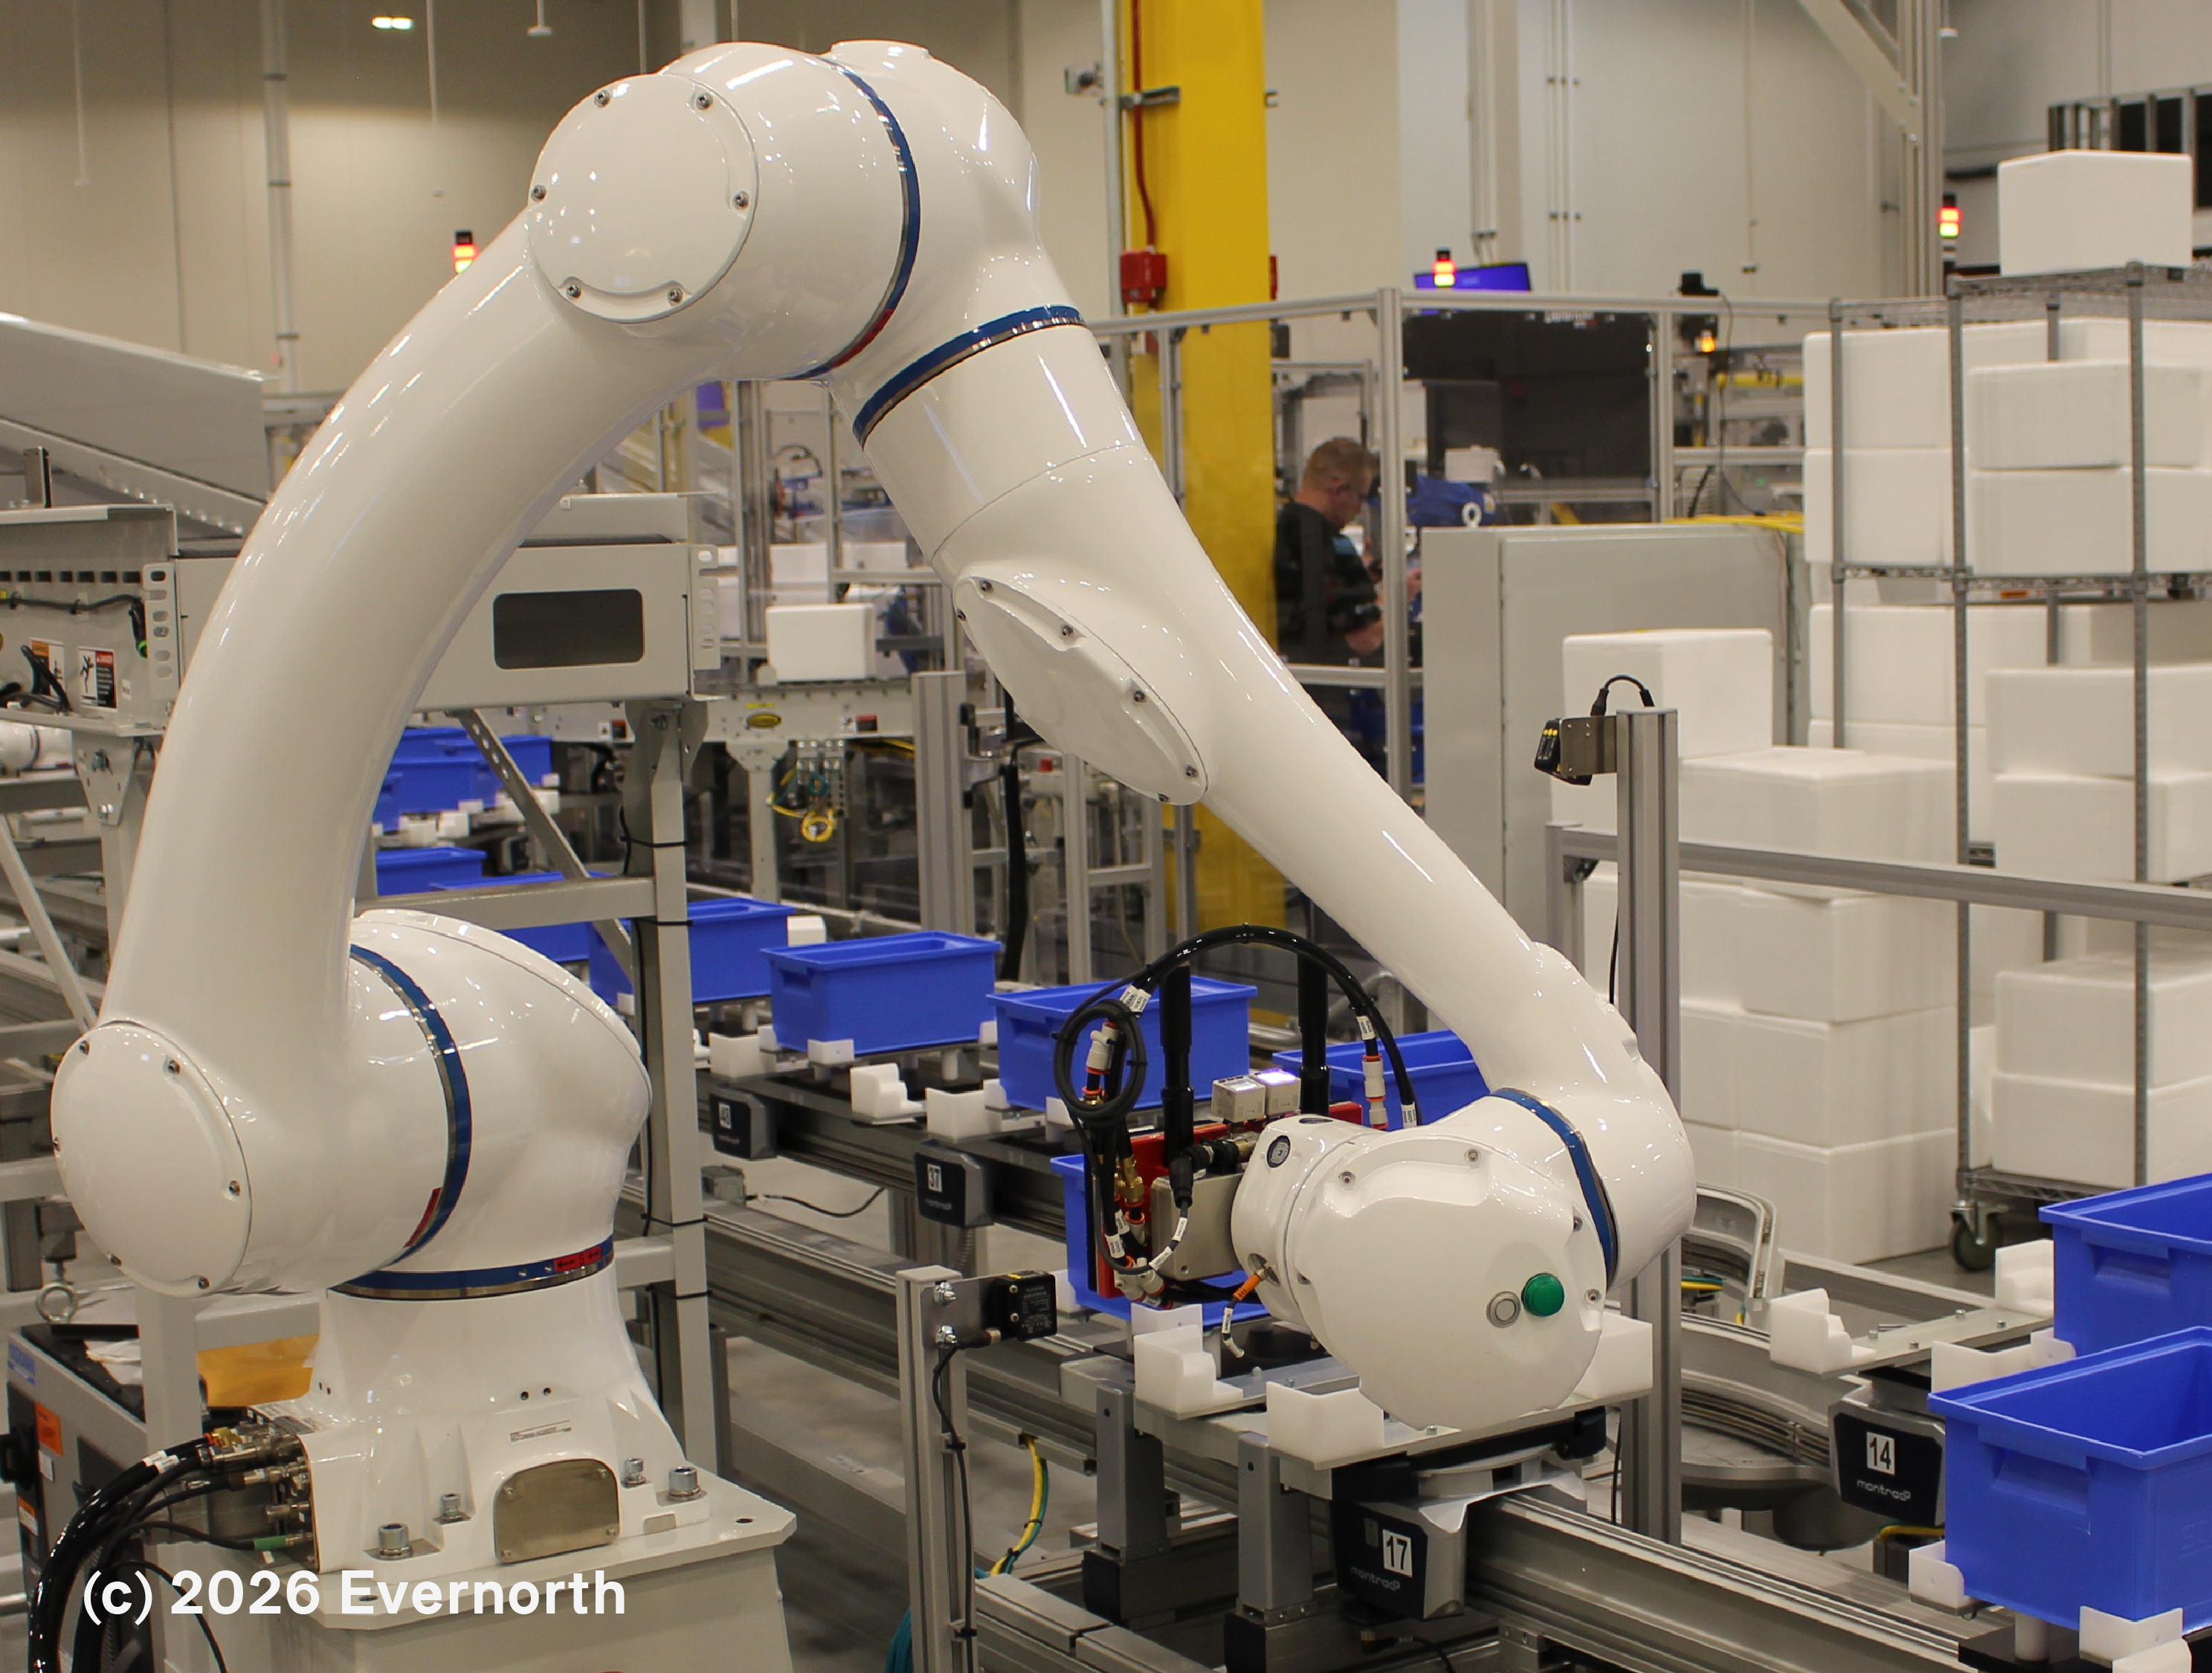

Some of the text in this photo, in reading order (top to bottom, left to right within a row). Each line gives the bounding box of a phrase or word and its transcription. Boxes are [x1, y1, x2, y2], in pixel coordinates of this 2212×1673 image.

[929, 1167, 941, 1190] 37
[1869, 1437, 1892, 1470] 14
[1386, 1535, 1408, 1570] 17
